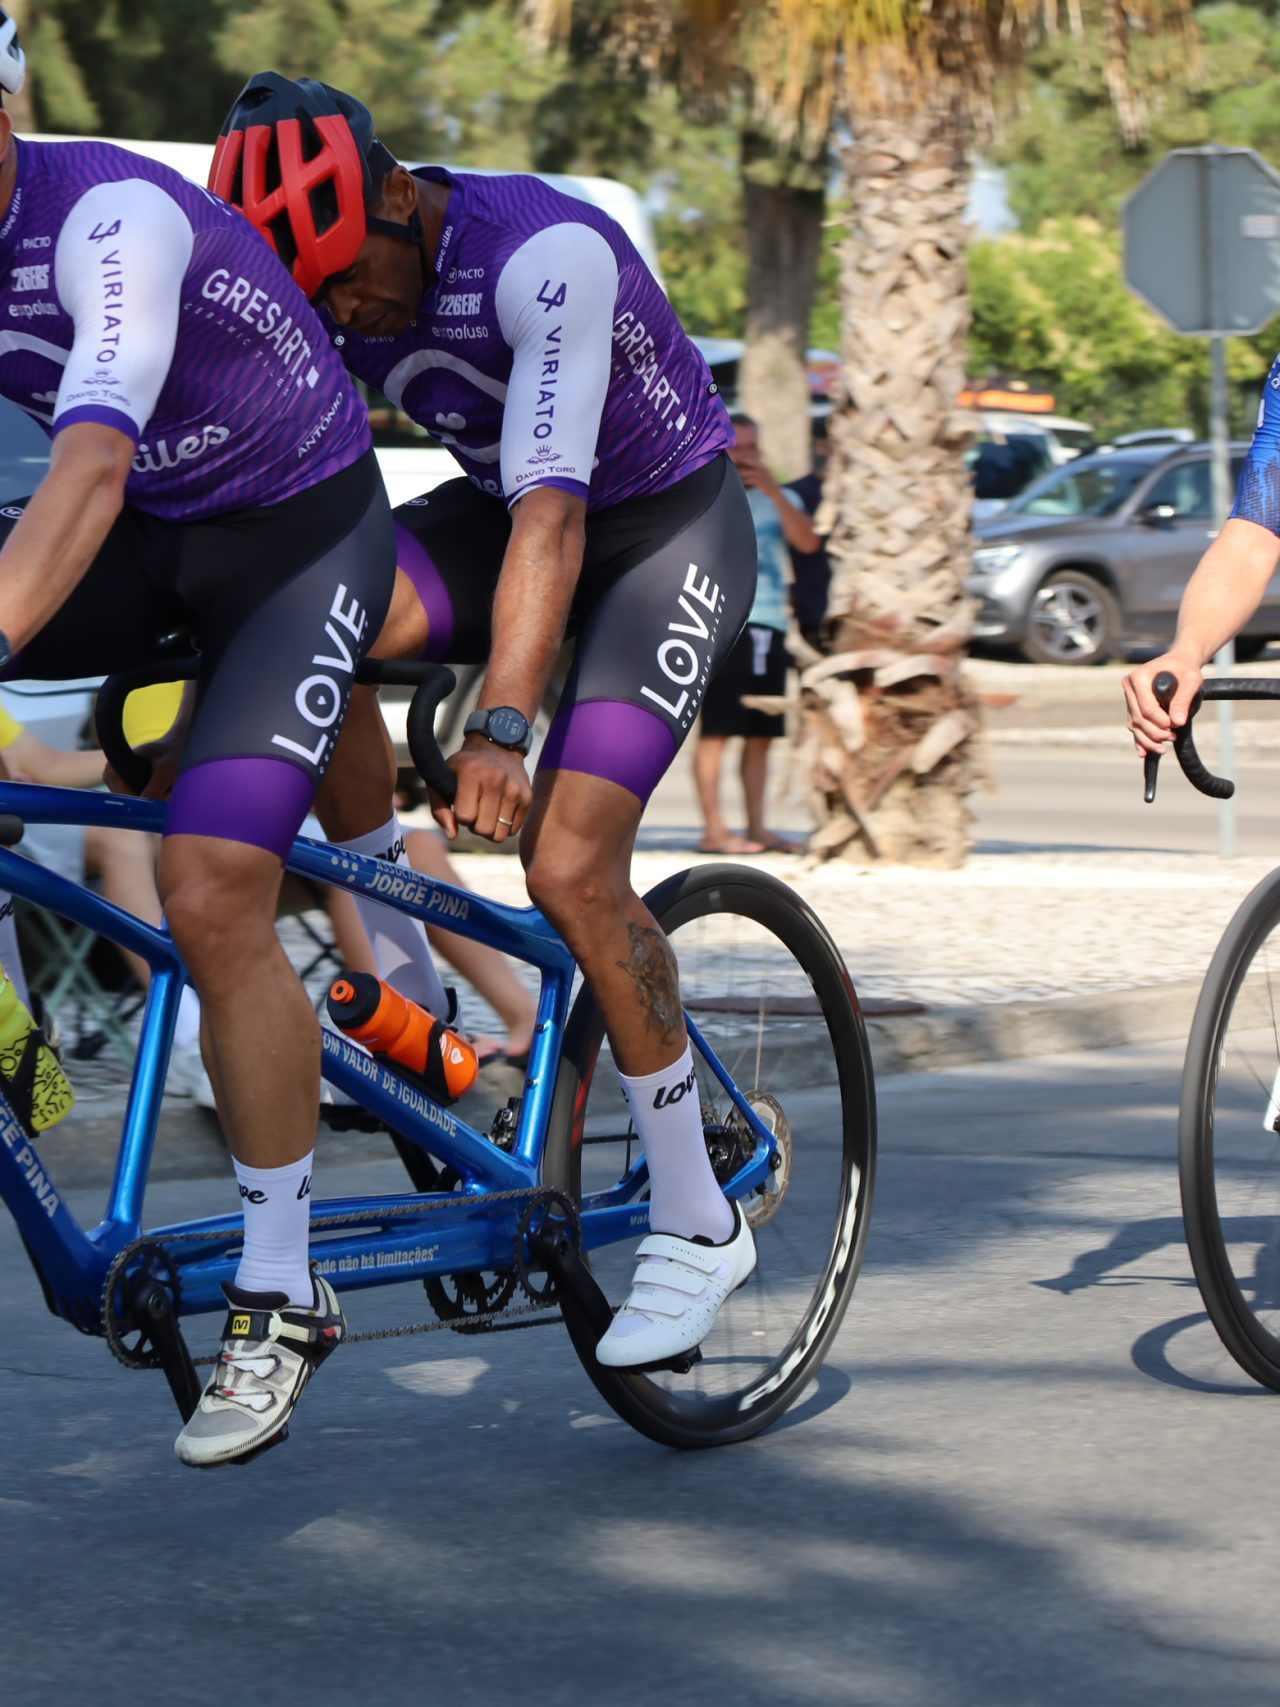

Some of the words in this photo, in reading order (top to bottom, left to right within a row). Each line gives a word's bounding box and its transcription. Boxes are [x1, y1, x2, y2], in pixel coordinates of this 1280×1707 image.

[96, 250, 123, 362] VIRIATO
[457, 268, 485, 279] PACTO
[533, 325, 562, 439] VIRIATO
[271, 583, 367, 766] LOVE
[640, 563, 719, 719] LOVE
[681, 655, 712, 728] CERAMIC
[711, 594, 726, 643] TILES
[365, 871, 425, 905] JORGE
[428, 890, 470, 920] PINA
[342, 1043, 378, 1082] VALOR
[382, 1071, 397, 1095] DE
[398, 1085, 457, 1138] IGUALDADE
[16, 1146, 61, 1219] PINA
[339, 1255, 359, 1272] não
[361, 1252, 376, 1269] há
